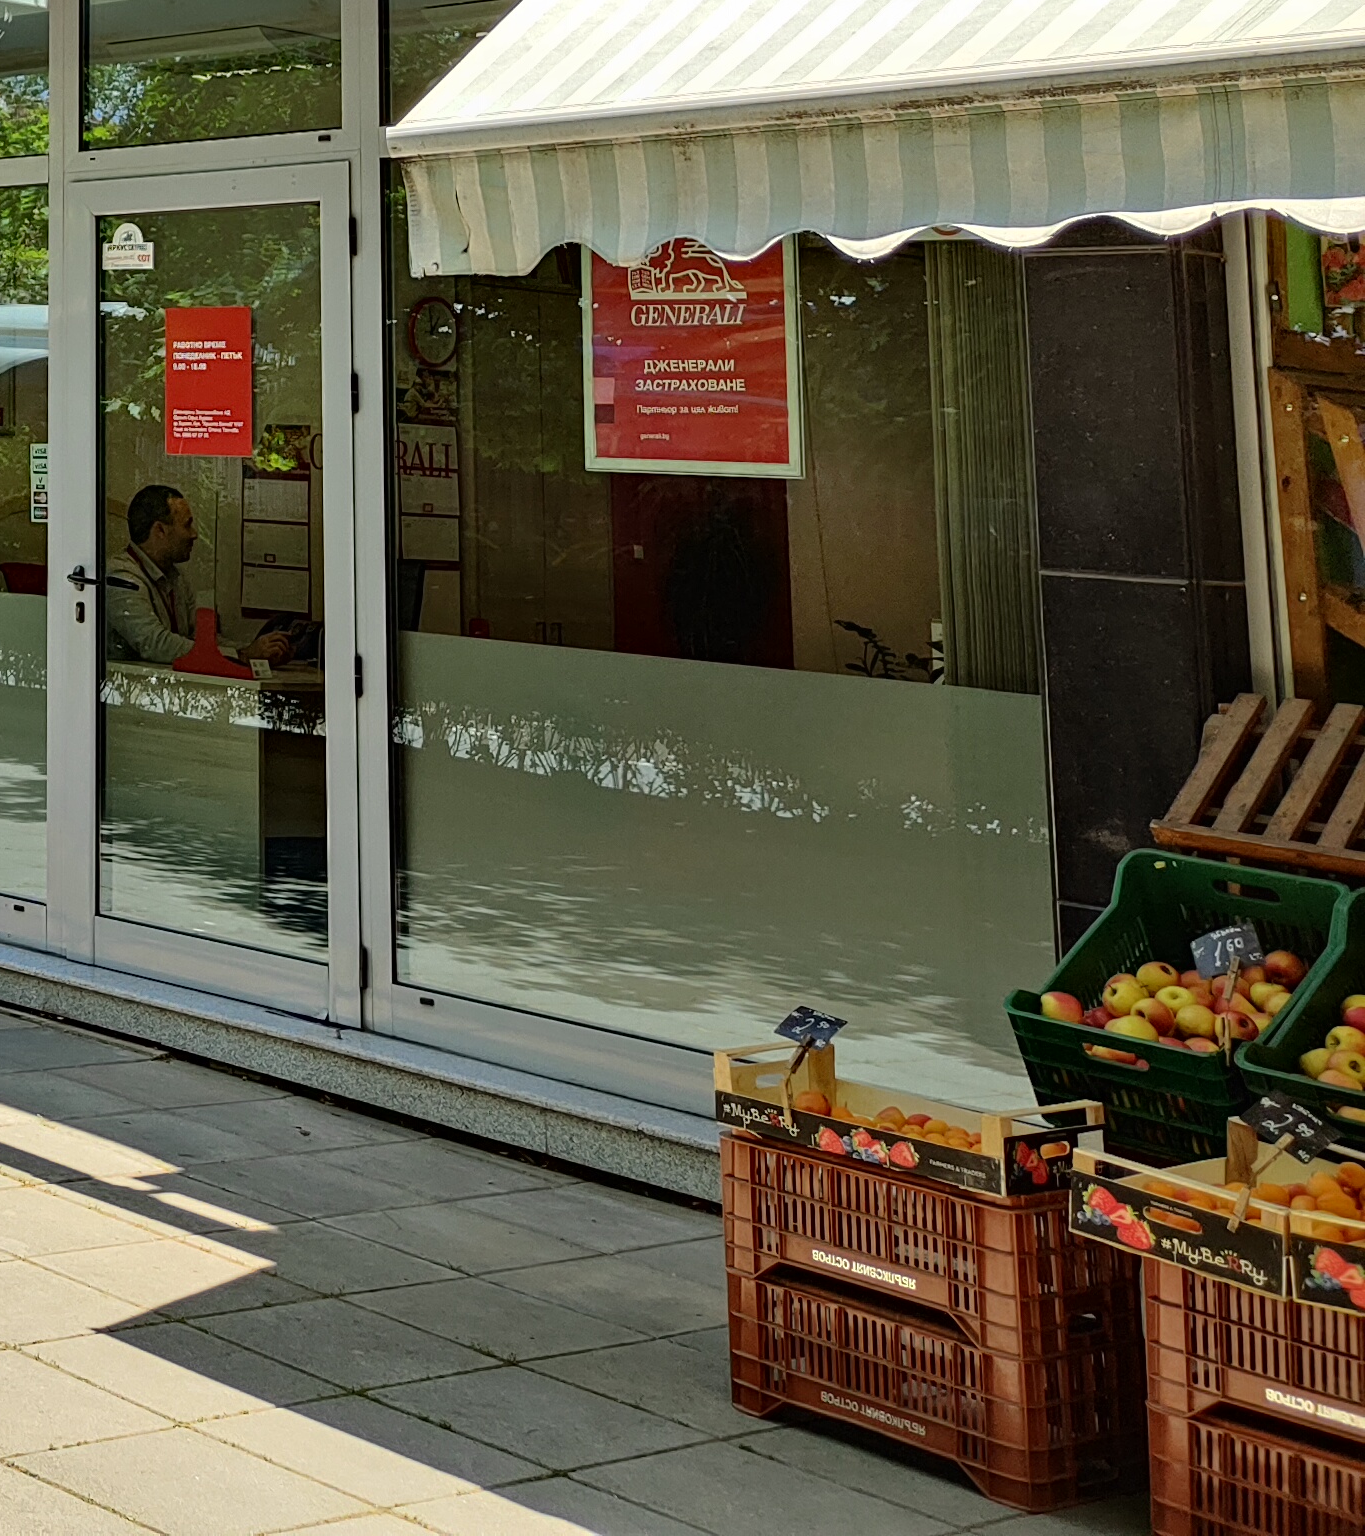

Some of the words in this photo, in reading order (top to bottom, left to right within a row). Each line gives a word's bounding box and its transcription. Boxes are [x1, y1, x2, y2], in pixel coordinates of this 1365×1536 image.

[630, 304, 747, 326] GENERALI
[644, 360, 735, 374] ДЖЕНЕРАЛИ
[635, 379, 746, 392] ЗАСТРАХОВАНЕ
[636, 404, 677, 416] Партньор
[812, 1249, 850, 1270] ОСТРОВ
[820, 1390, 859, 1411] ОСТРОВ
[1265, 1388, 1314, 1414] ОСТРОВ
